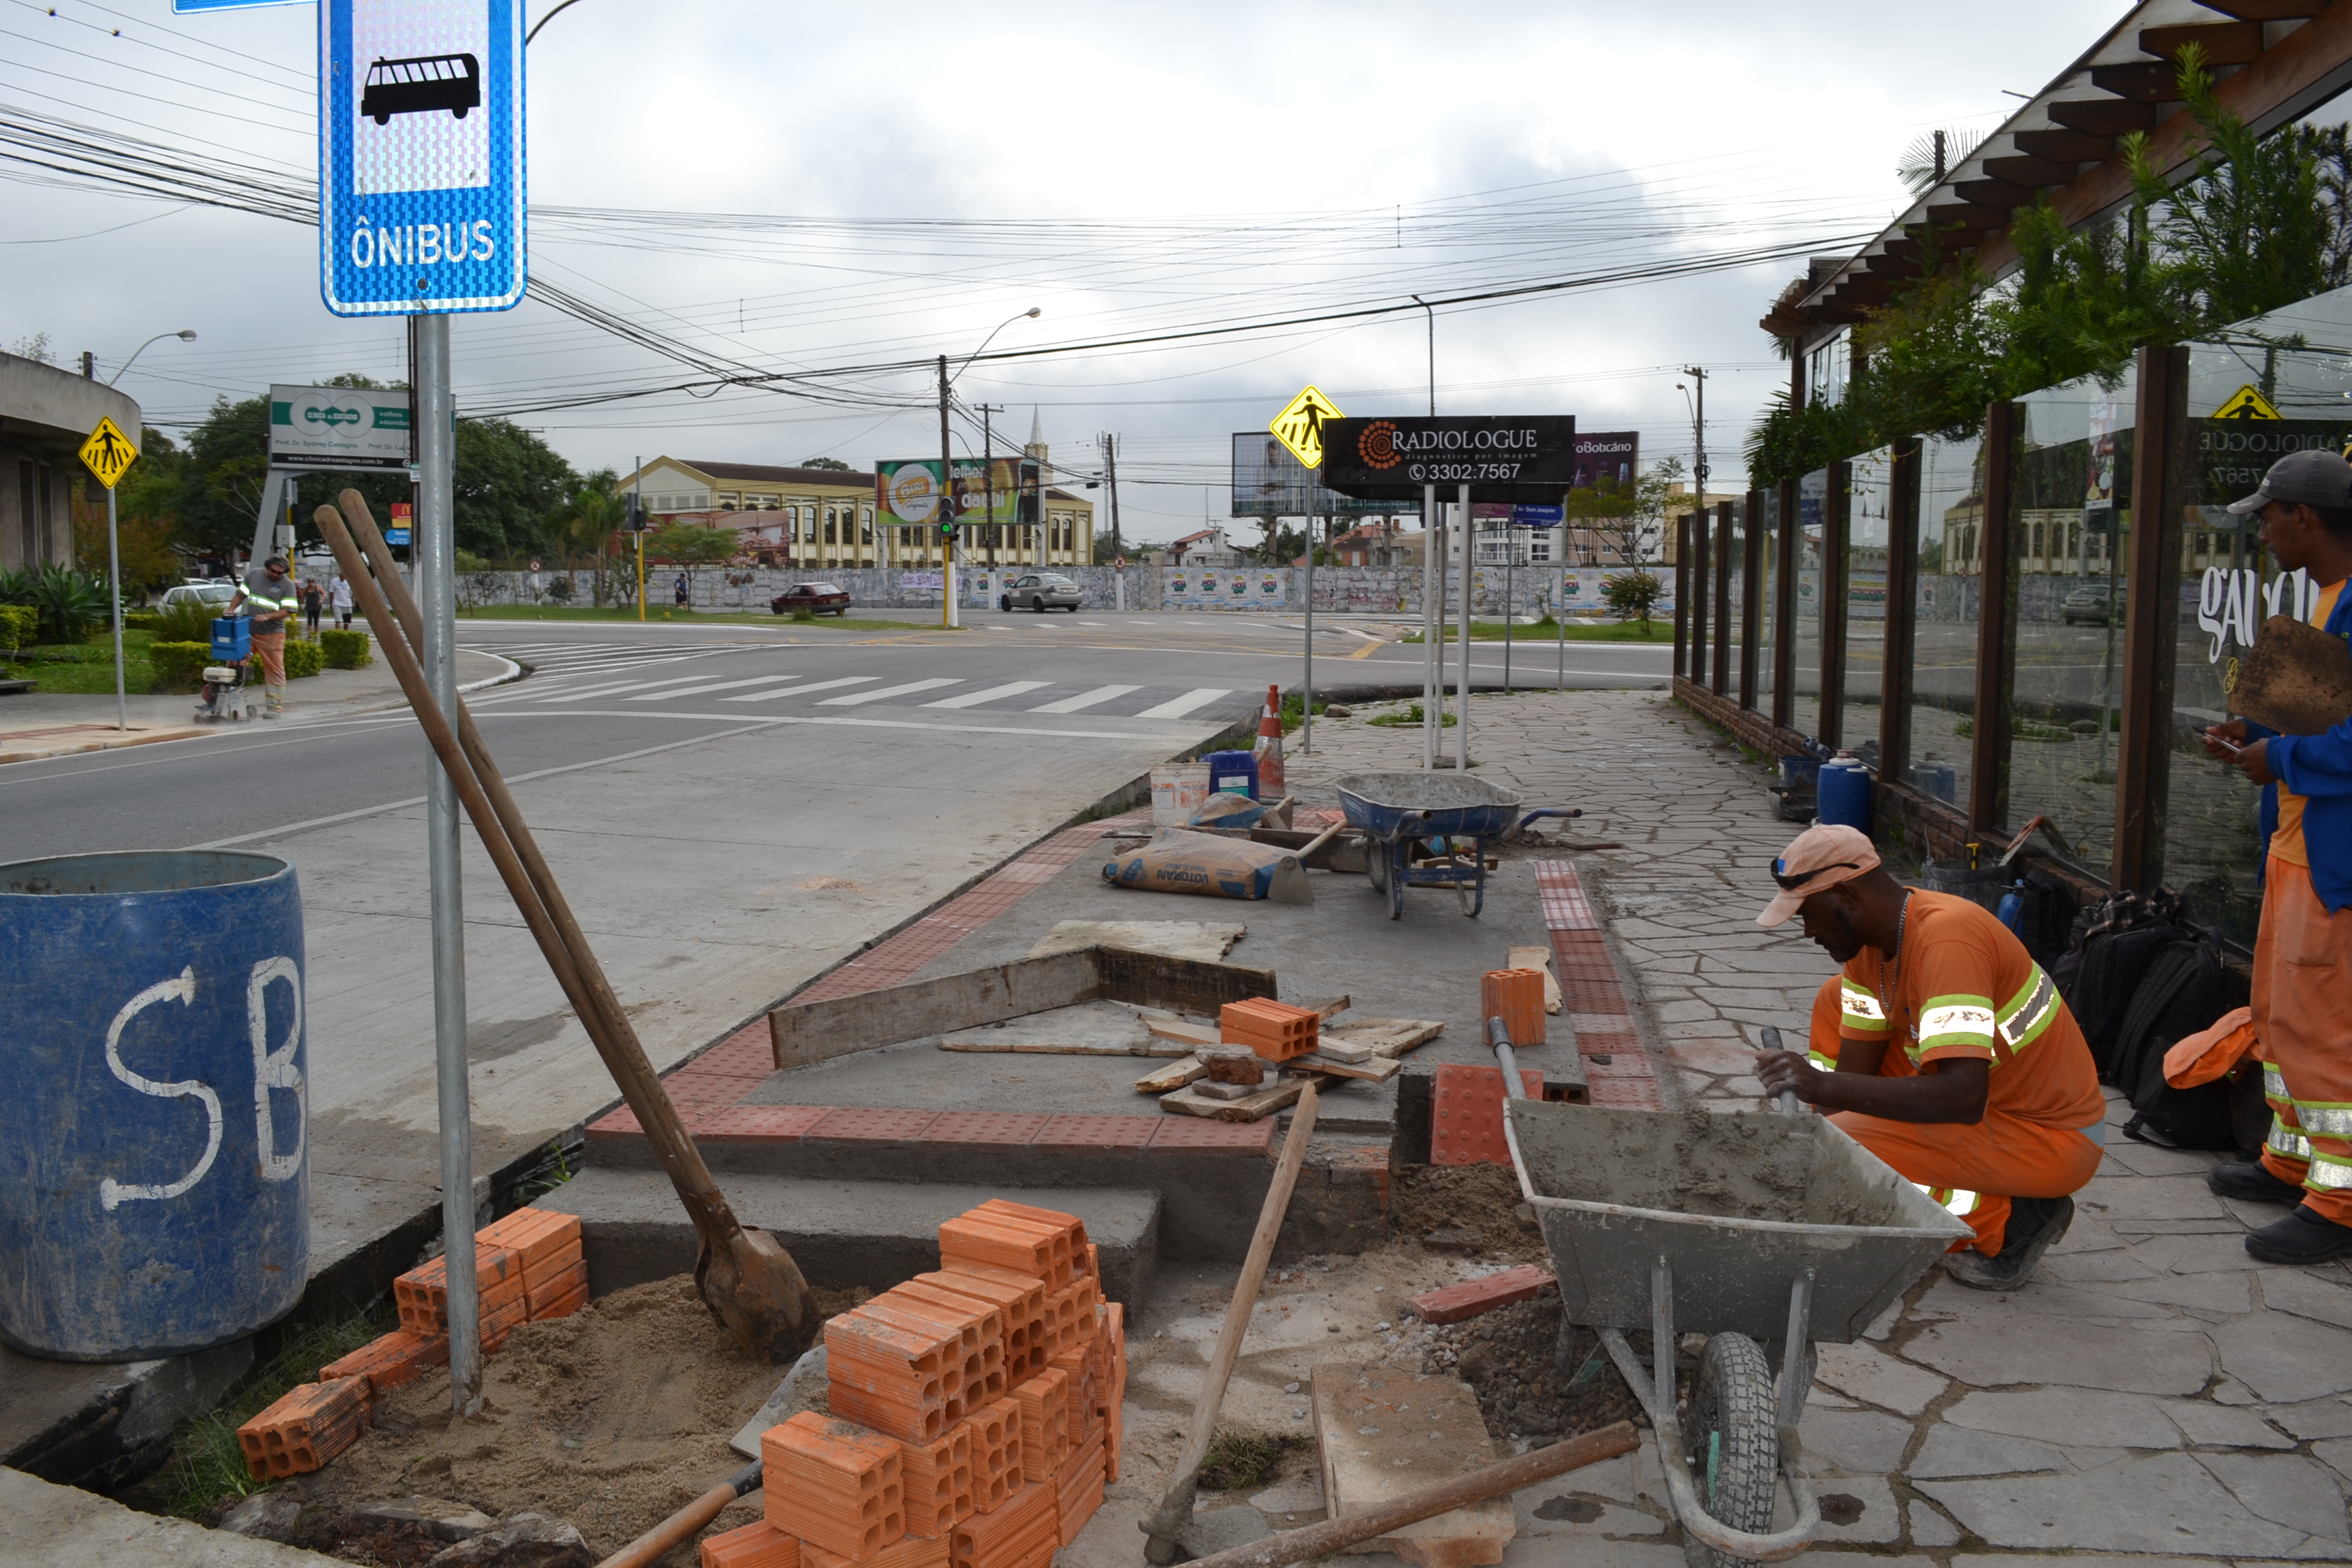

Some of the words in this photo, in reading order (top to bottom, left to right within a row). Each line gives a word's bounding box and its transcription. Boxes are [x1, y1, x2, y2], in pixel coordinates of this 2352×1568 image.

[351, 216, 495, 268] ÔNIBUS
[303, 440, 327, 448] Sydney
[328, 441, 359, 449] Castagno
[1392, 429, 1537, 452] RADIOLOGUE
[288, 455, 384, 466] www.clinicadrcastagno.com.br
[1405, 453, 1468, 461] diagnóstico
[1429, 463, 1521, 480] 3302.7567
[1156, 869, 1209, 884] VOTORAN
